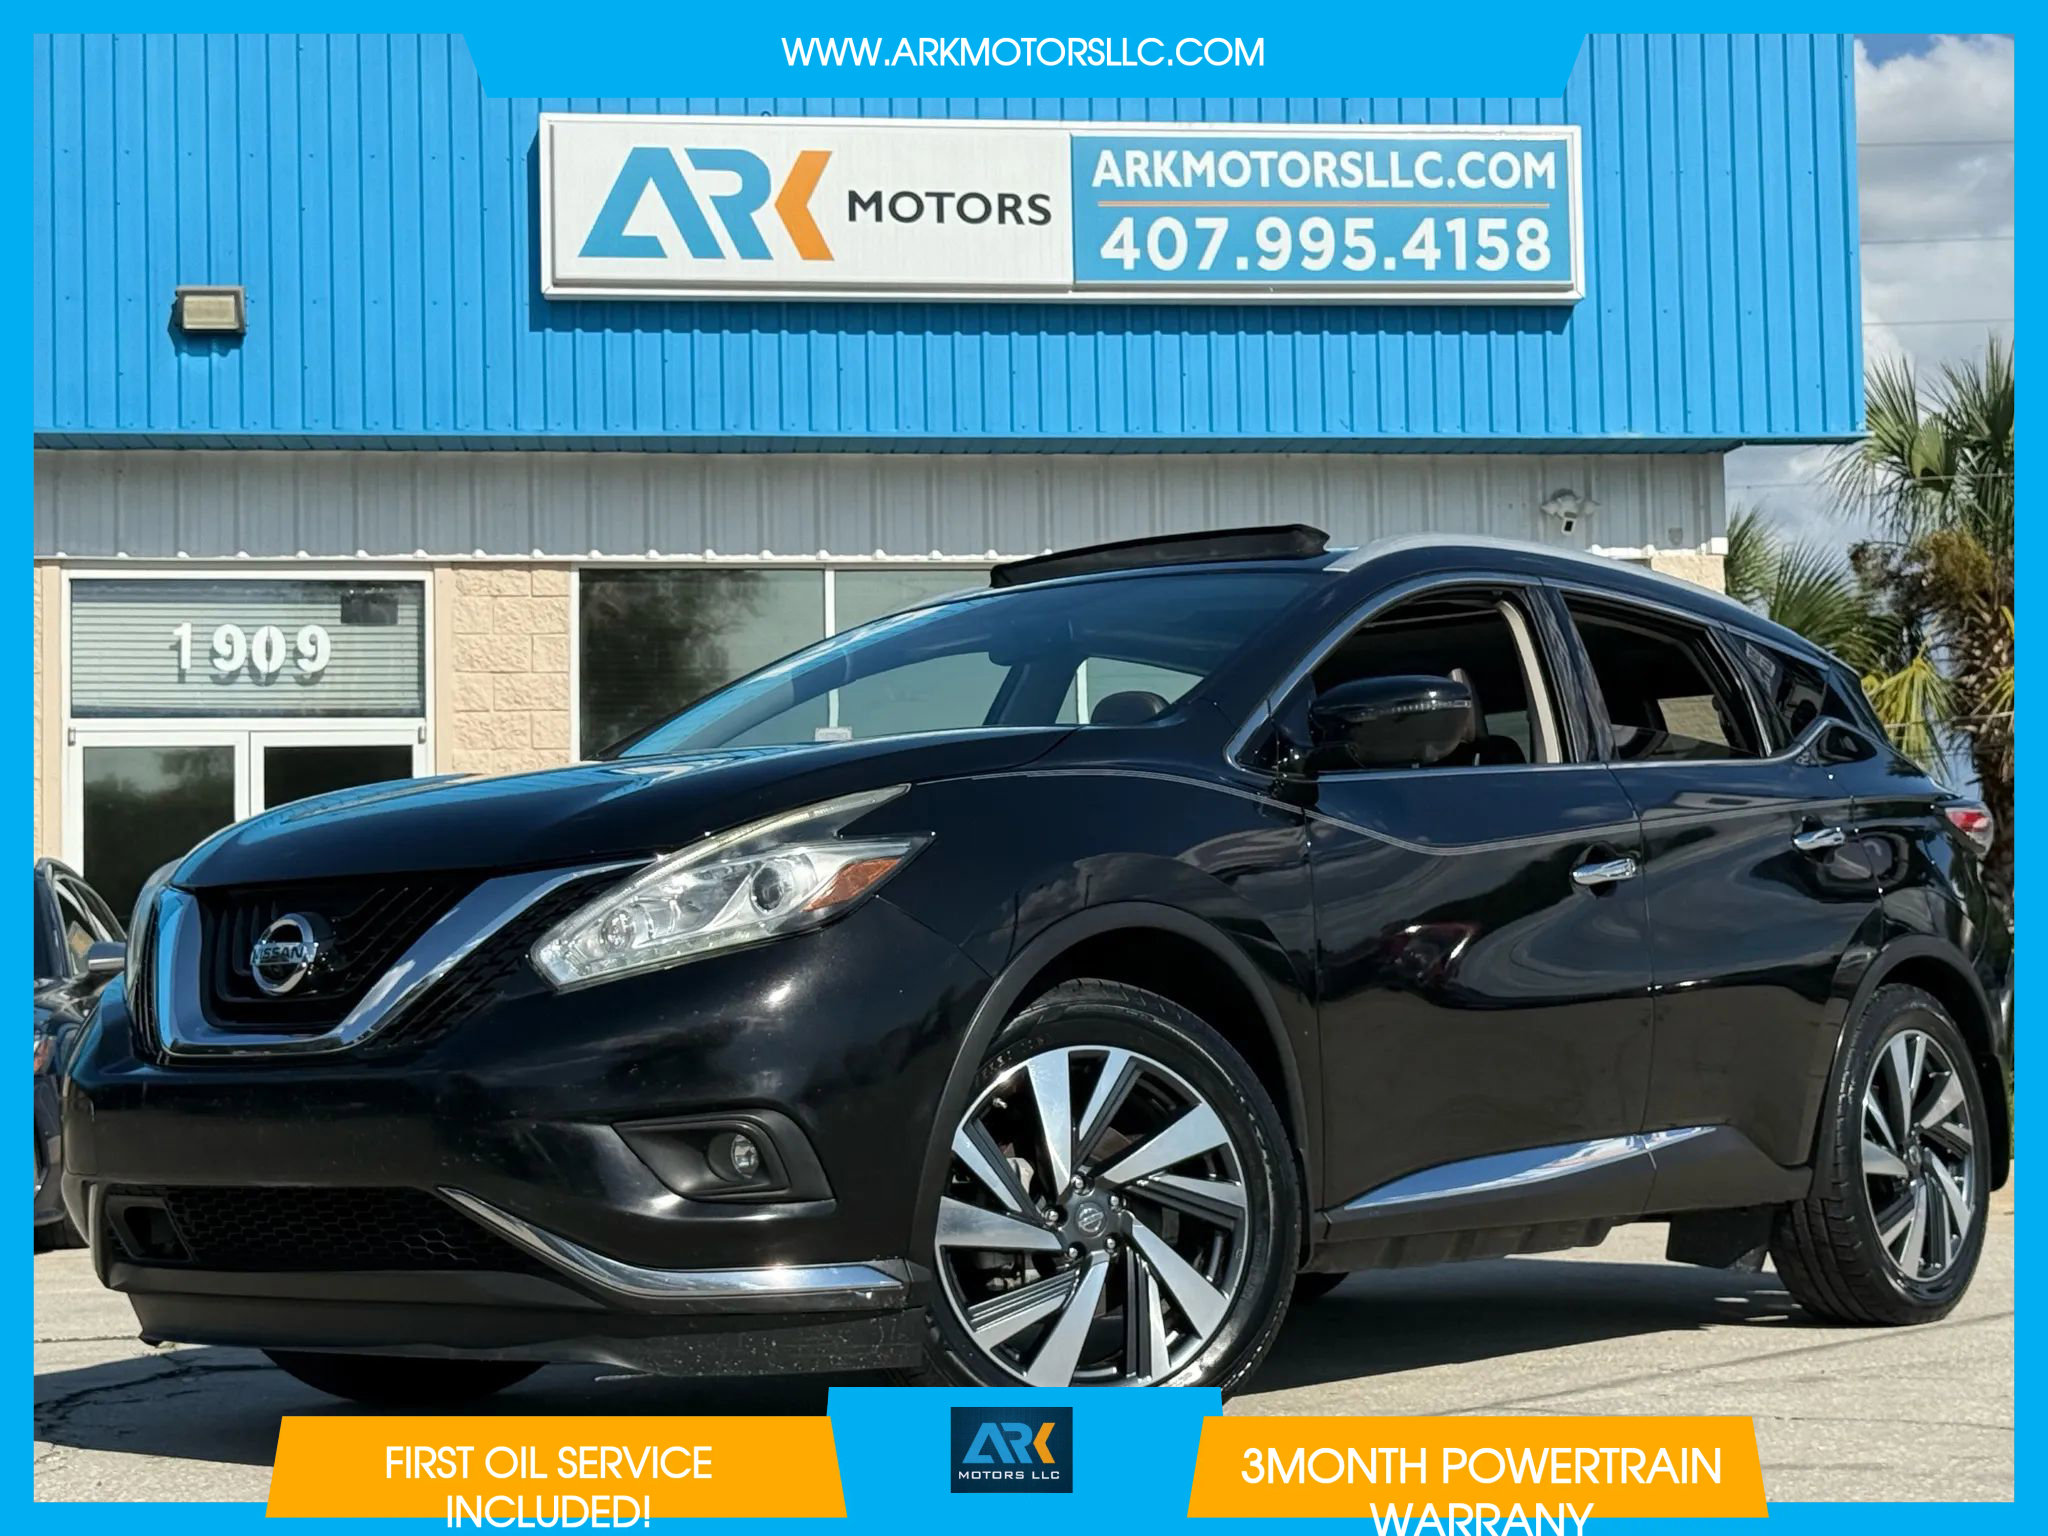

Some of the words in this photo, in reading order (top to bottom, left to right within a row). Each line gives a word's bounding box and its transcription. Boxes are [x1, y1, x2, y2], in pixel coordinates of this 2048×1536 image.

[1092, 149, 1556, 190] ARKMOTORSLLC.COM
[578, 146, 834, 261] ARK
[848, 190, 1052, 225] MOTORS
[1100, 216, 1551, 272] 407.995.4158
[172, 622, 332, 674] 1909
[252, 945, 305, 963] NISSAN
